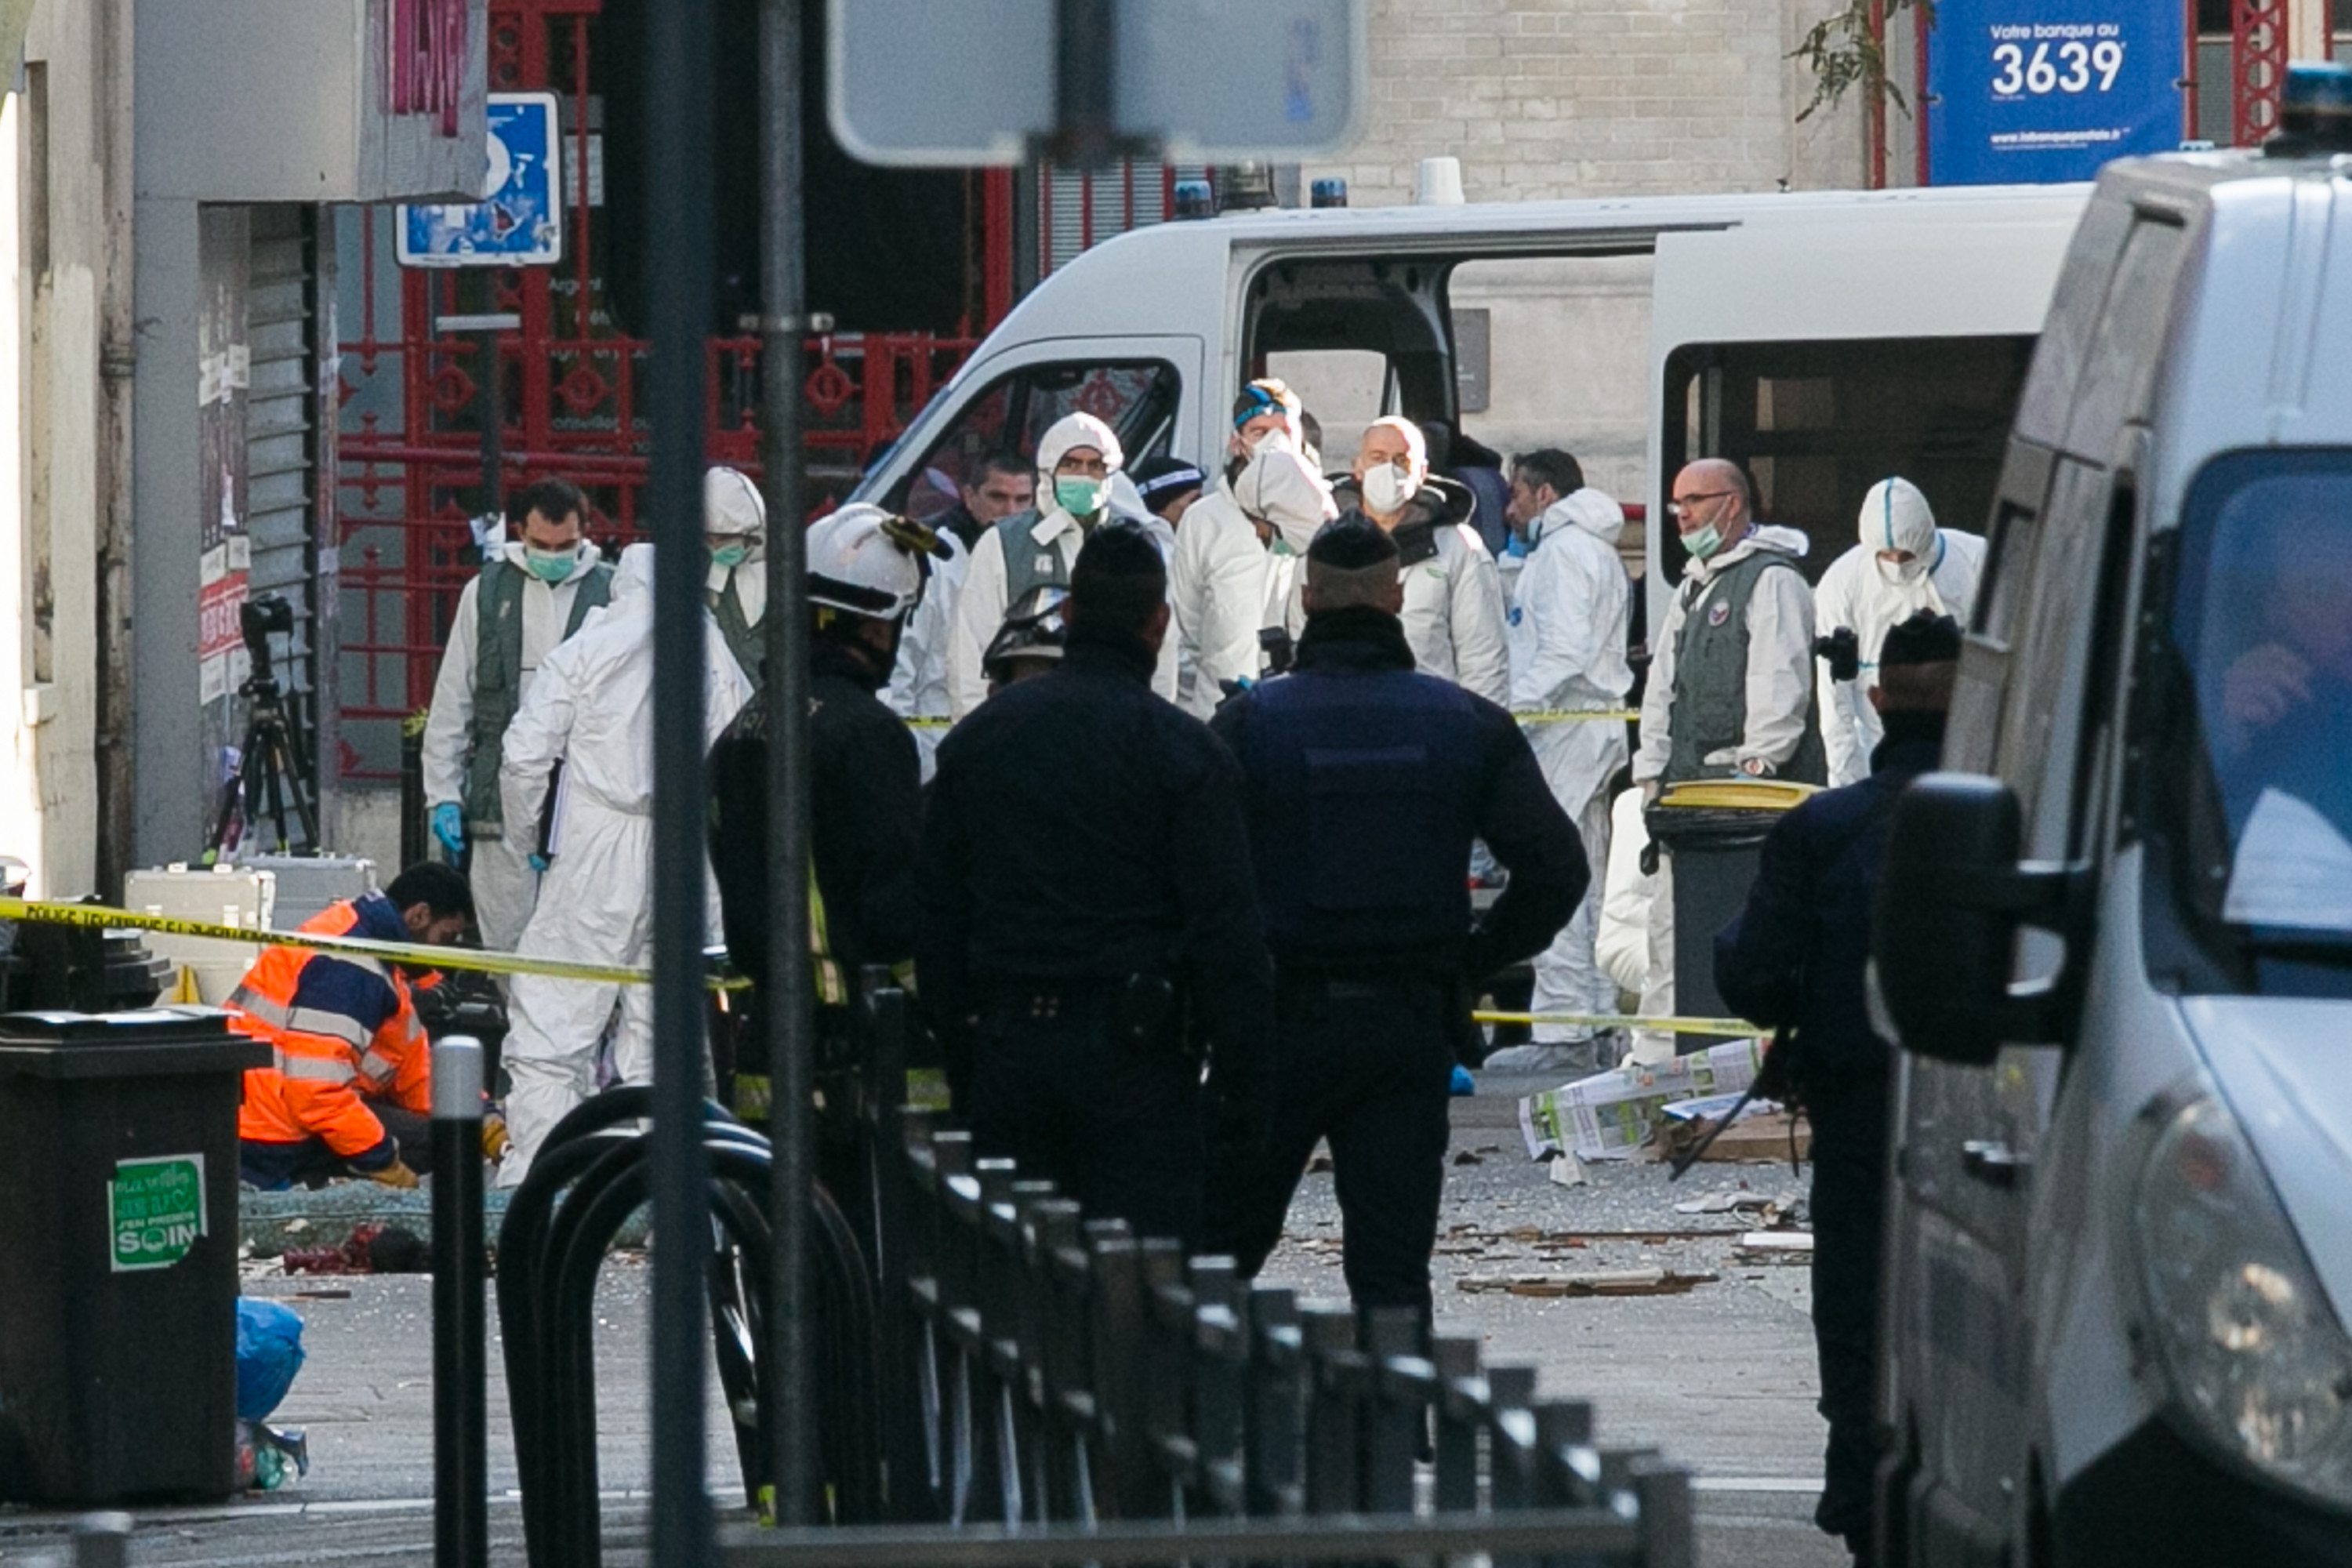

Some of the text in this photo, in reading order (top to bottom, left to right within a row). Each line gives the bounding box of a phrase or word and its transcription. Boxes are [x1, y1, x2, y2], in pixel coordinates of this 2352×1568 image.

[1990, 24, 2119, 39] Votre banque au
[1992, 41, 2122, 94] 3639
[27, 905, 77, 923] POLICE
[118, 1223, 197, 1254] SOIN
